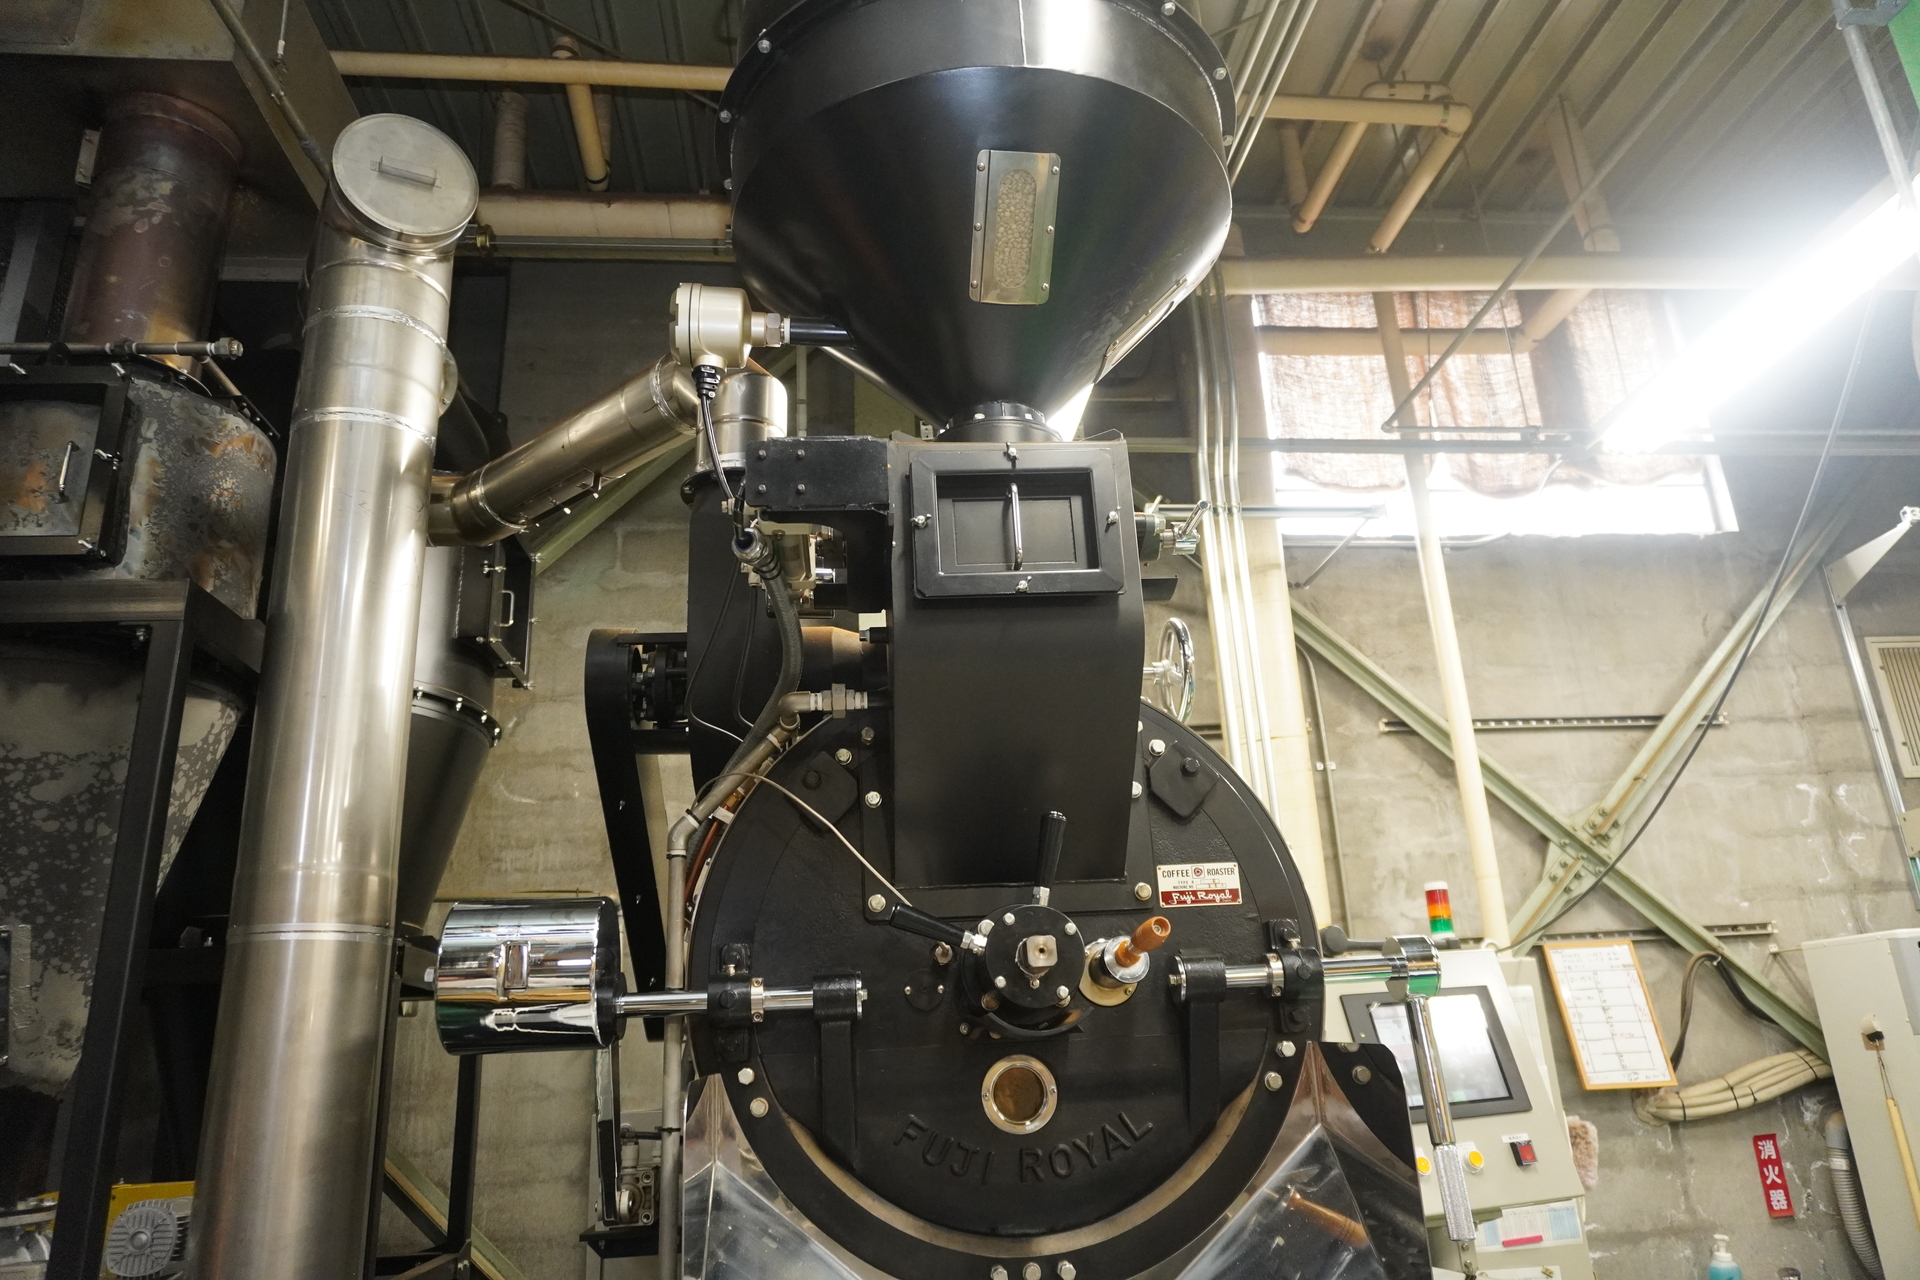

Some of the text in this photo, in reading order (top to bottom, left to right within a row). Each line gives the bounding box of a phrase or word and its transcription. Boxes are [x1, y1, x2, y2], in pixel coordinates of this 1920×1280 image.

[1162, 868, 1235, 878] COFFEE ROASTER
[1168, 889, 1232, 905] Fuji Royal
[893, 1111, 1154, 1185] FUJI ROYAL
[1757, 1139, 1788, 1210] 消火器
